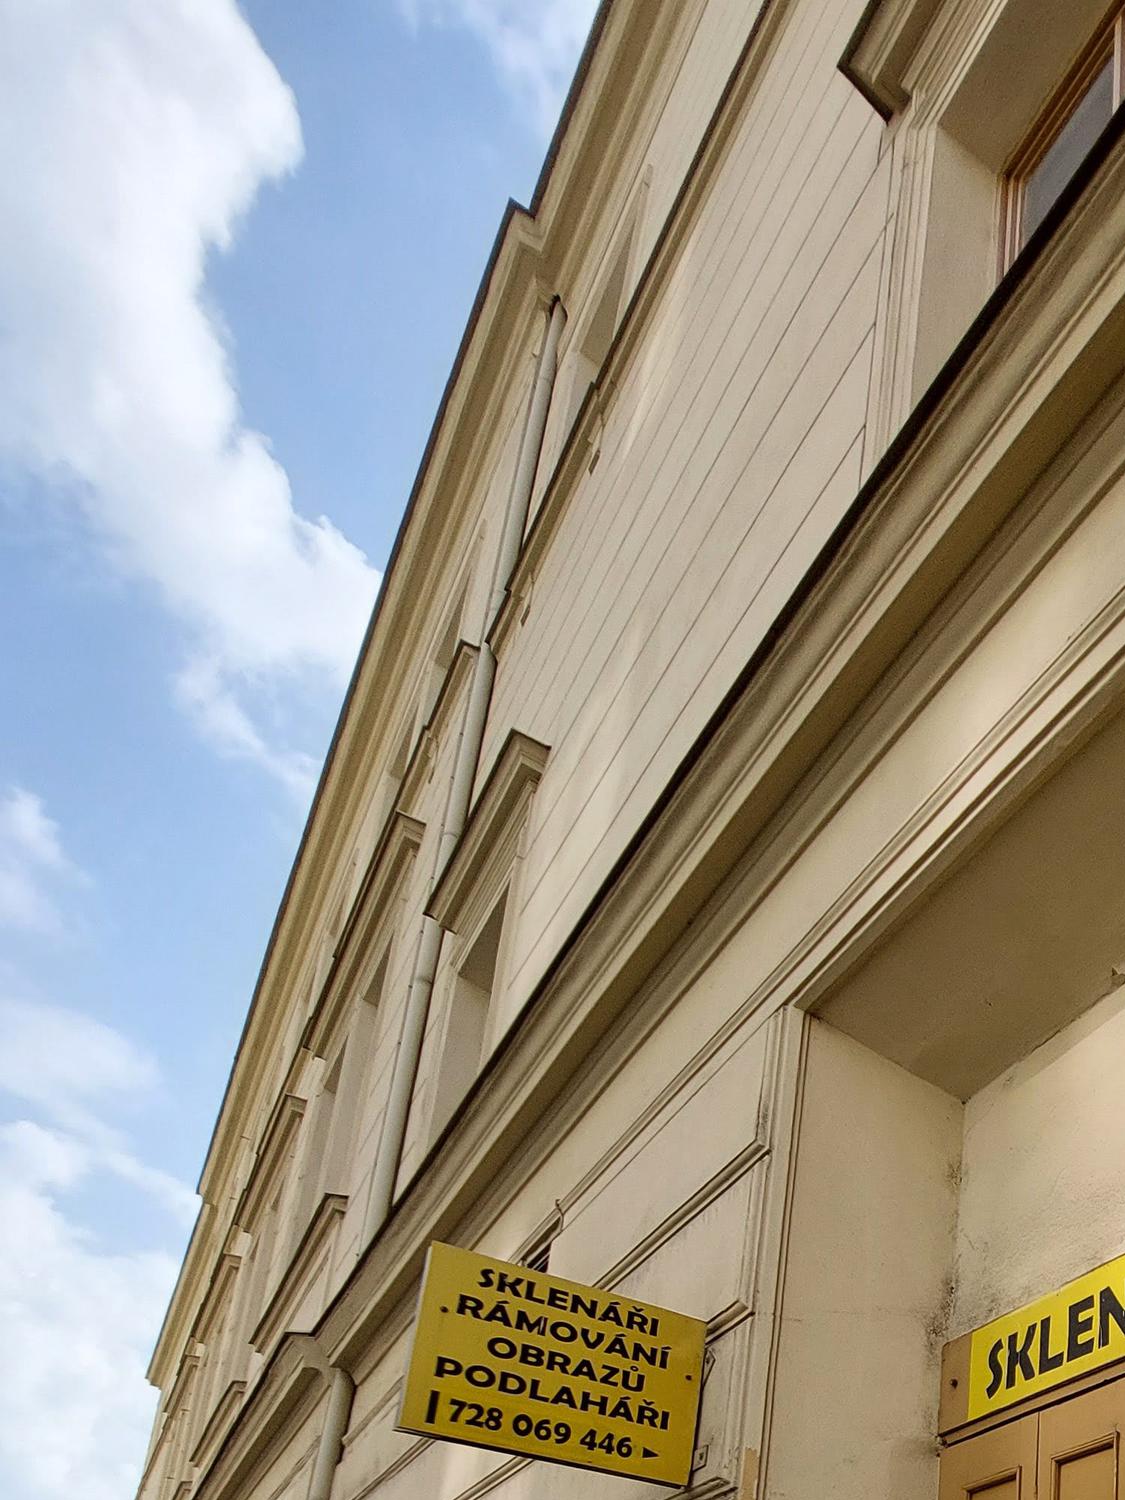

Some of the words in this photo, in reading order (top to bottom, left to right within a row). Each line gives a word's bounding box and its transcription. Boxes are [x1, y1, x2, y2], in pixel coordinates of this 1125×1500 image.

[456, 1294, 672, 1369] RÁMOVÁNÍ
[477, 1268, 660, 1337] SKLENÁŘI
[434, 1356, 670, 1431] PODLAHÁŘI
[487, 1337, 646, 1392] OBRAZŮ
[449, 1399, 503, 1431] 728
[512, 1413, 571, 1444] 069
[579, 1429, 632, 1458] 446
